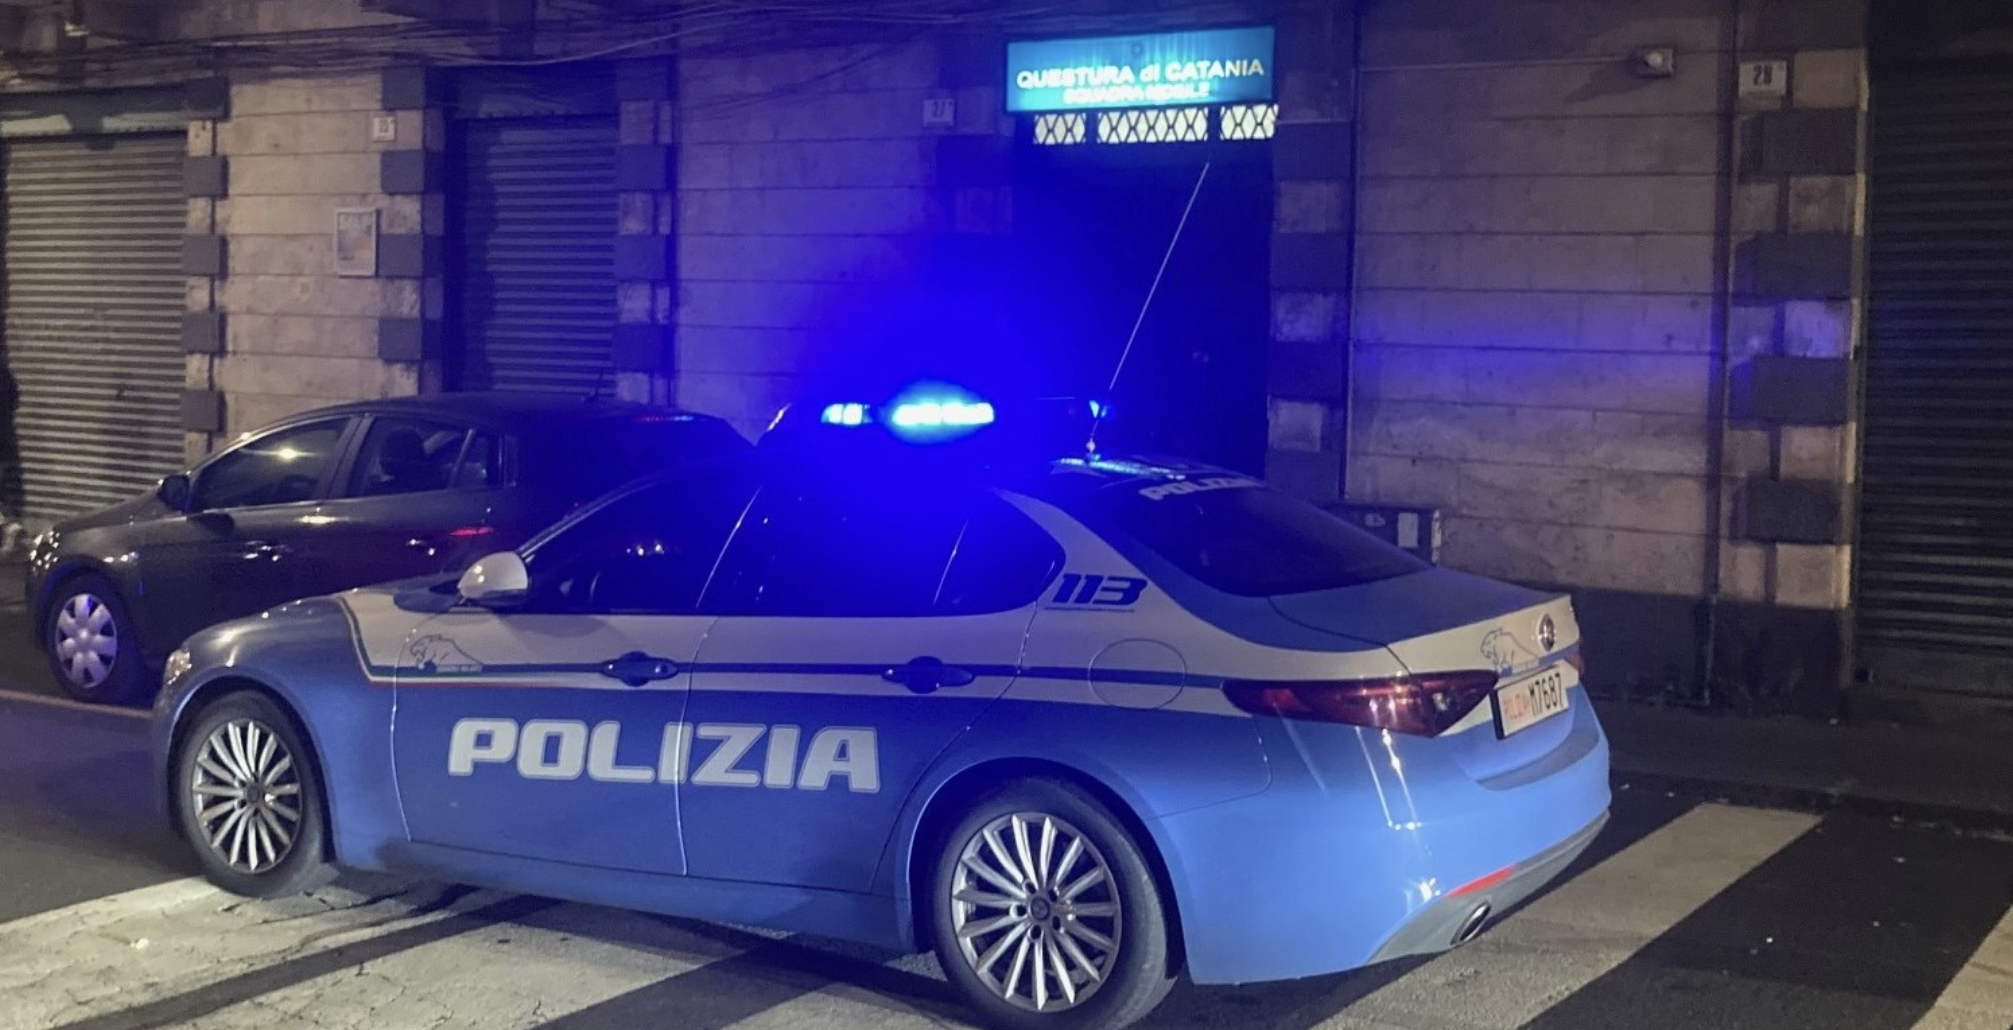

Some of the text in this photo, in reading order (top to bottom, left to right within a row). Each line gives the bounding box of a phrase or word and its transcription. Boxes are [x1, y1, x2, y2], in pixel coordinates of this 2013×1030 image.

[1017, 58, 1264, 89] QUESTURA di CATANIA
[1051, 573, 1148, 606] 113
[1528, 672, 1564, 717] M7687
[448, 717, 881, 793] POLIZIA
